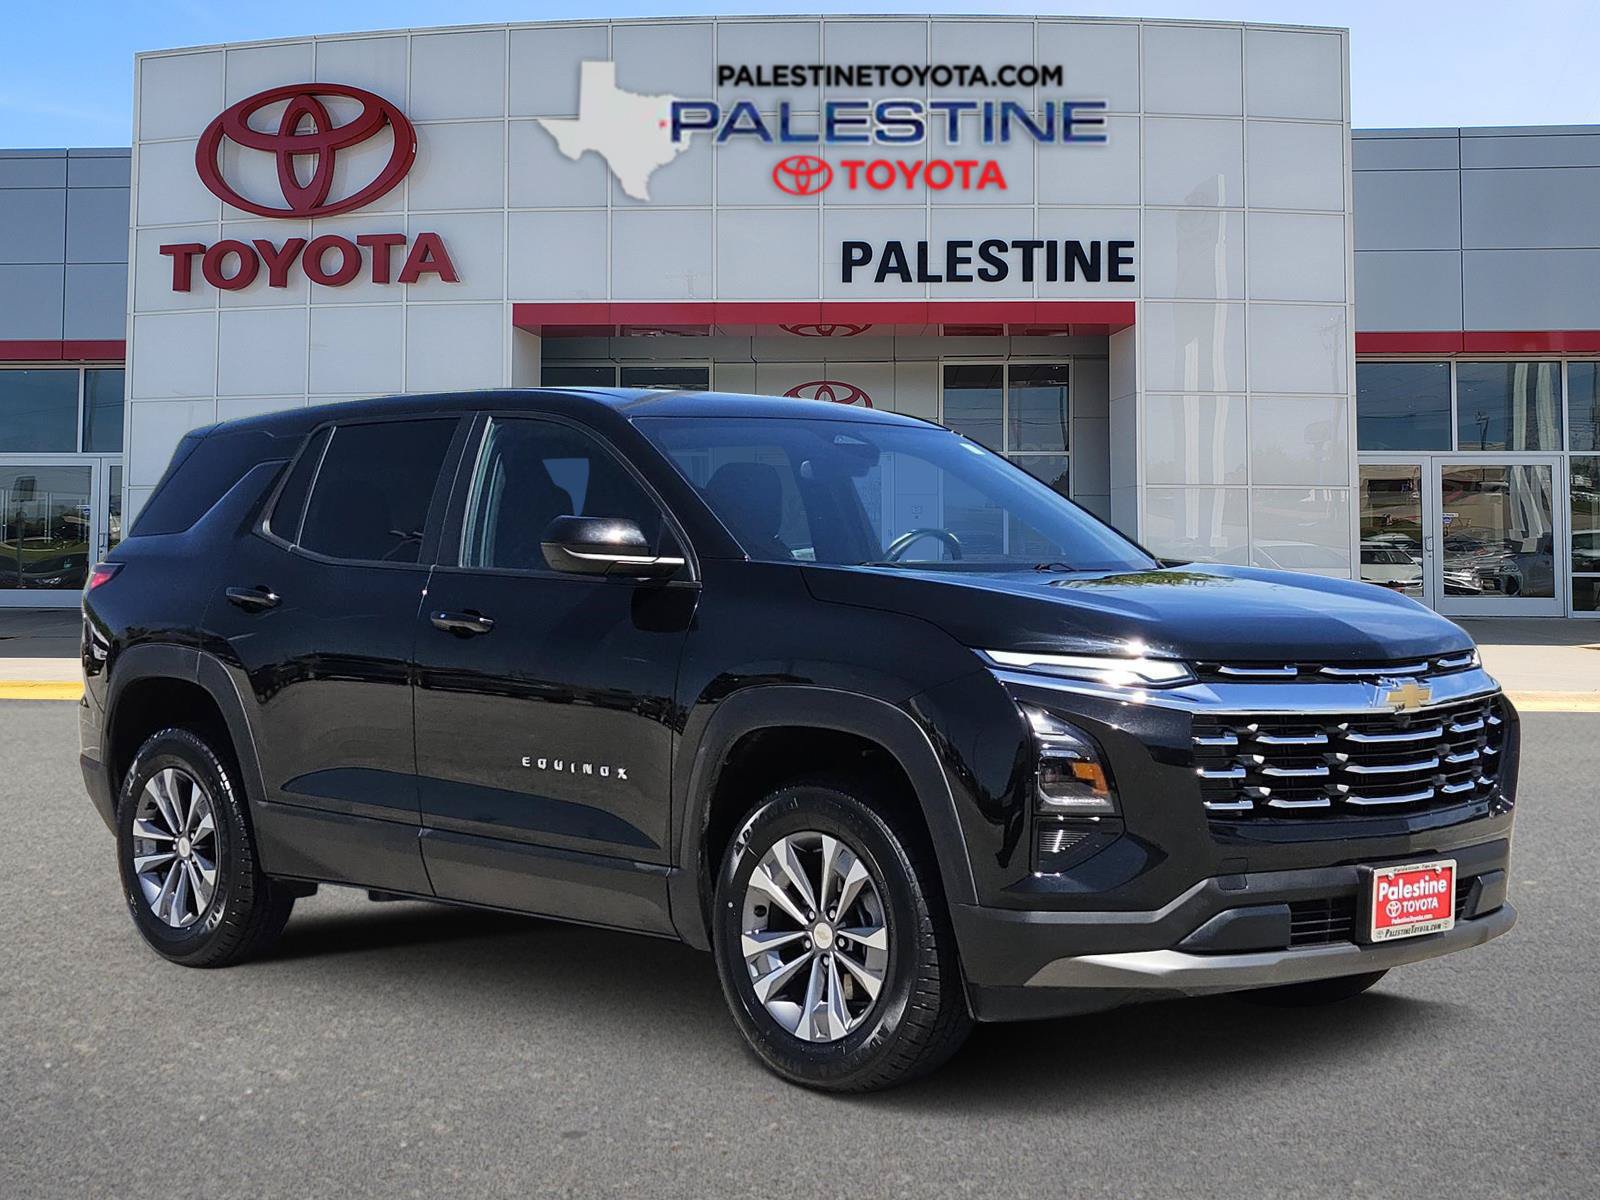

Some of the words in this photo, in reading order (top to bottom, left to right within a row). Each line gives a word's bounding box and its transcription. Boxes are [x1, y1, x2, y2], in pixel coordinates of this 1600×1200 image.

[159, 232, 460, 292] TOYOTA
[841, 239, 1136, 283] PALESTINE
[521, 756, 628, 780] EQUINOX
[1378, 875, 1447, 902] Palestine
[1402, 896, 1439, 913] TOYOTA
